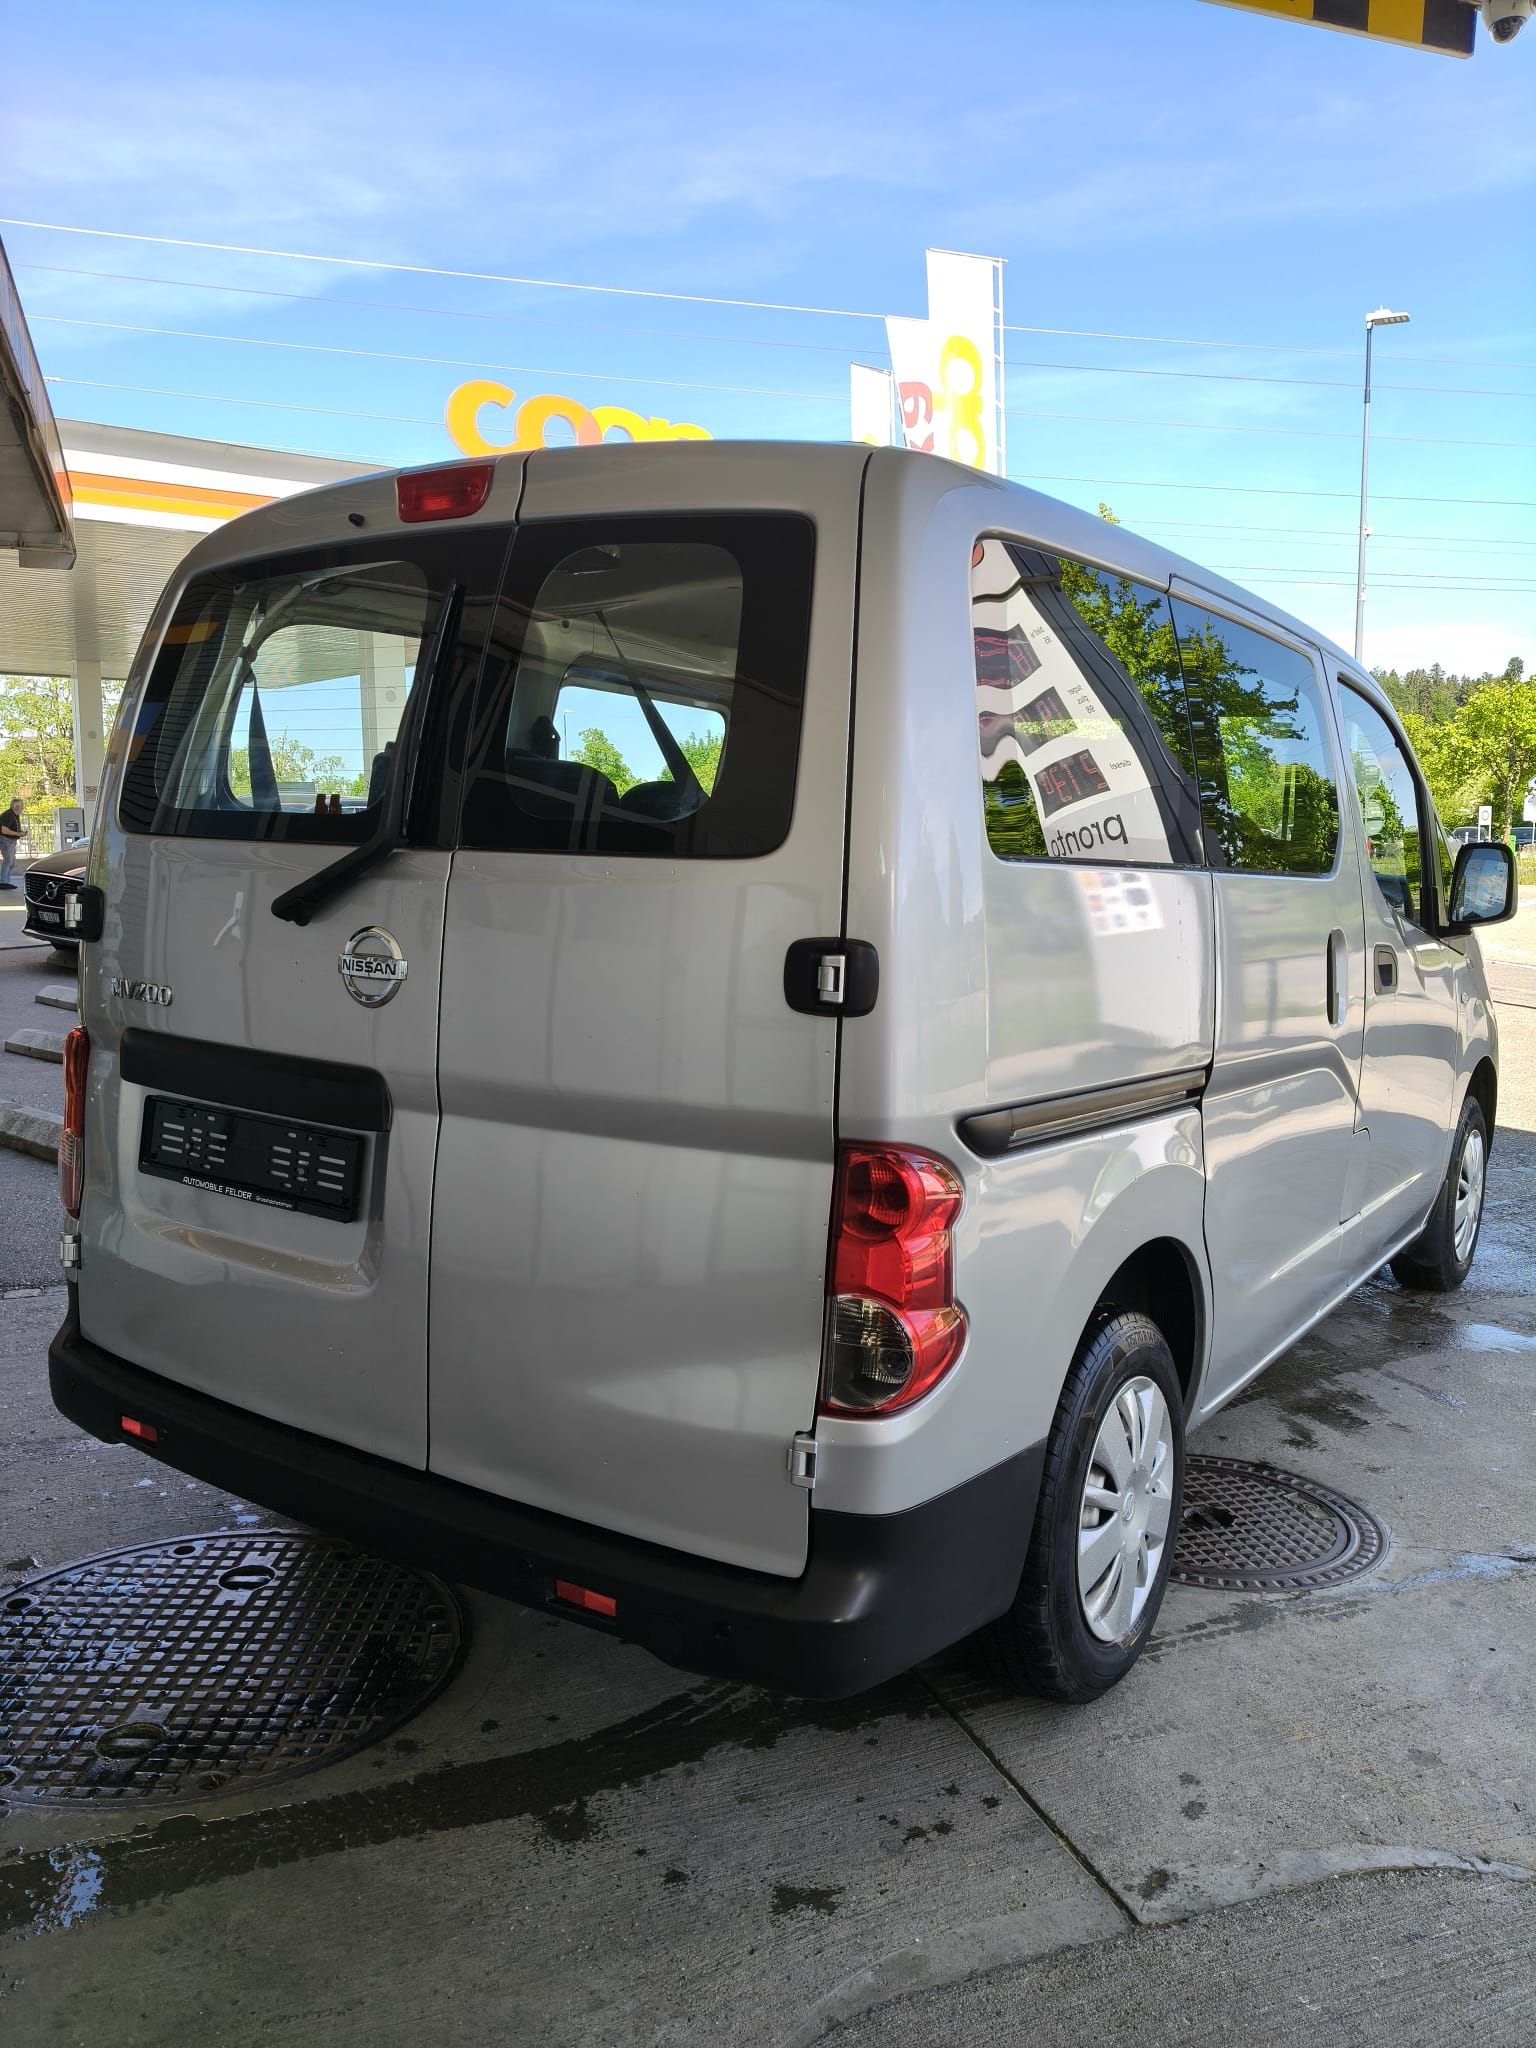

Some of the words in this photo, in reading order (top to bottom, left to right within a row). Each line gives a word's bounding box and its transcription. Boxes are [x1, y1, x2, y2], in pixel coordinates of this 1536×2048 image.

[342, 958, 397, 976] NISSAN
[111, 976, 173, 1006] NV200
[182, 1176, 224, 1193] AUTOMOBILE
[225, 1186, 253, 1200] FELDER
